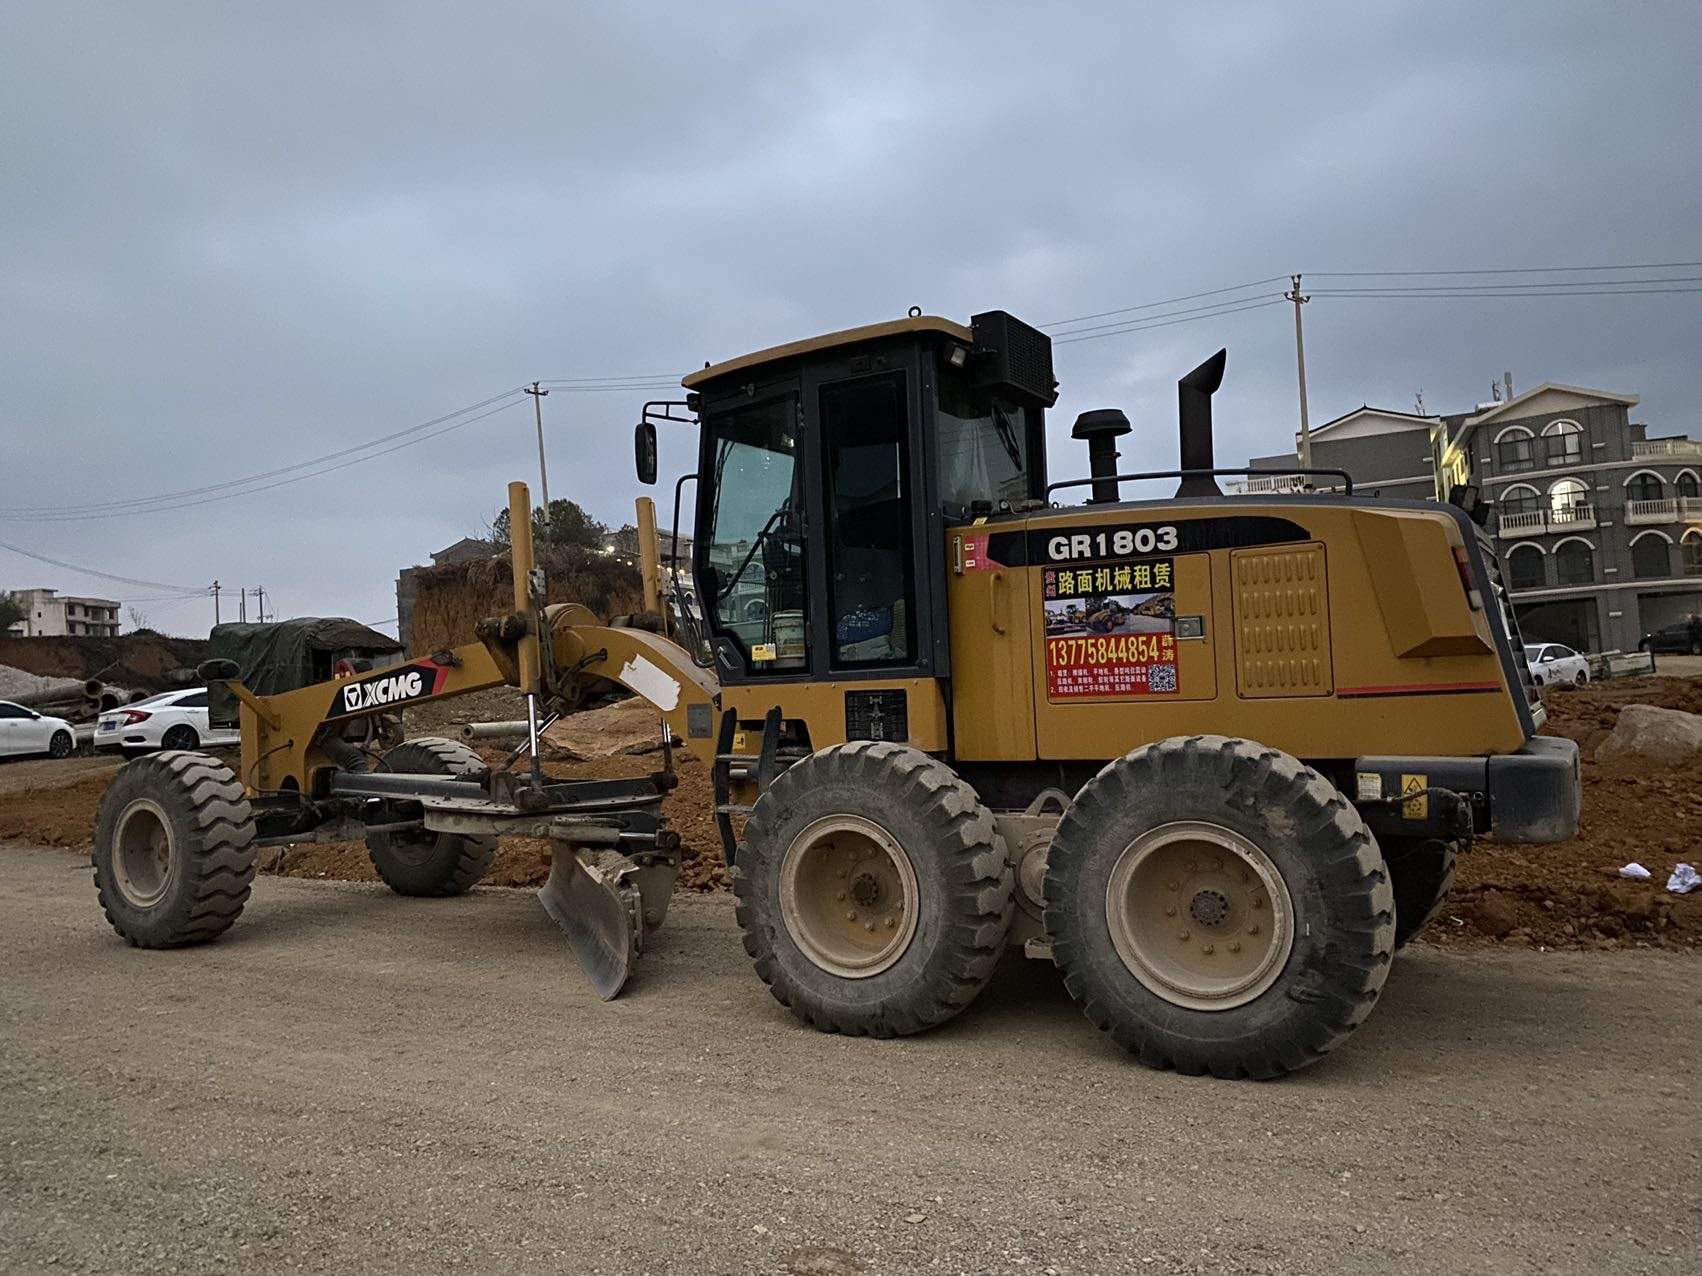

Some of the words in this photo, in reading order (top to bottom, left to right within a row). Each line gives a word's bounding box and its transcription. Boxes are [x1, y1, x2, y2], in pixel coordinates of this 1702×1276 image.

[1048, 526, 1178, 560] GR1803
[1058, 563, 1171, 595] 路面机械租赁
[1050, 636, 1159, 666] 13775844854
[363, 672, 422, 707] XCMG
